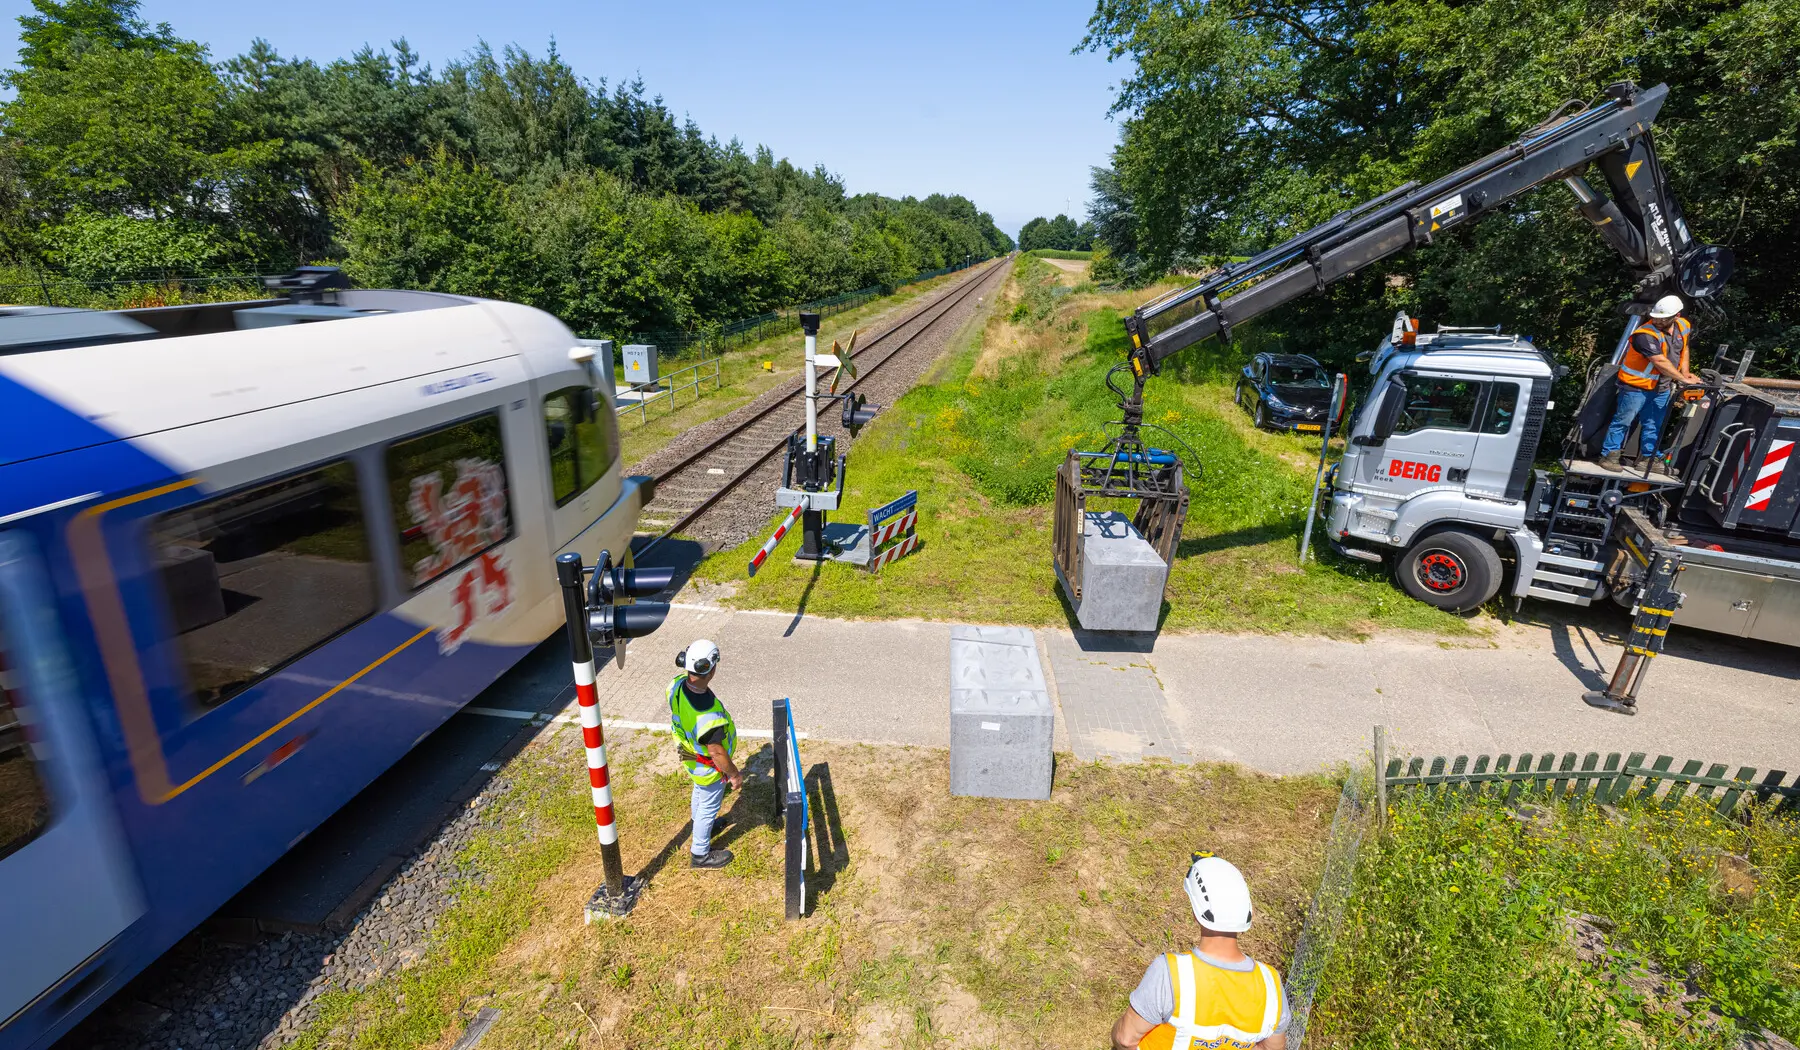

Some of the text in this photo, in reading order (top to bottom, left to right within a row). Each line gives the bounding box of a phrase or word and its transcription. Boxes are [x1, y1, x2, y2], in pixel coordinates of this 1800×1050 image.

[1648, 202, 1664, 226] ATLAS
[1388, 459, 1442, 483] BERG
[873, 505, 893, 522] WACHT
